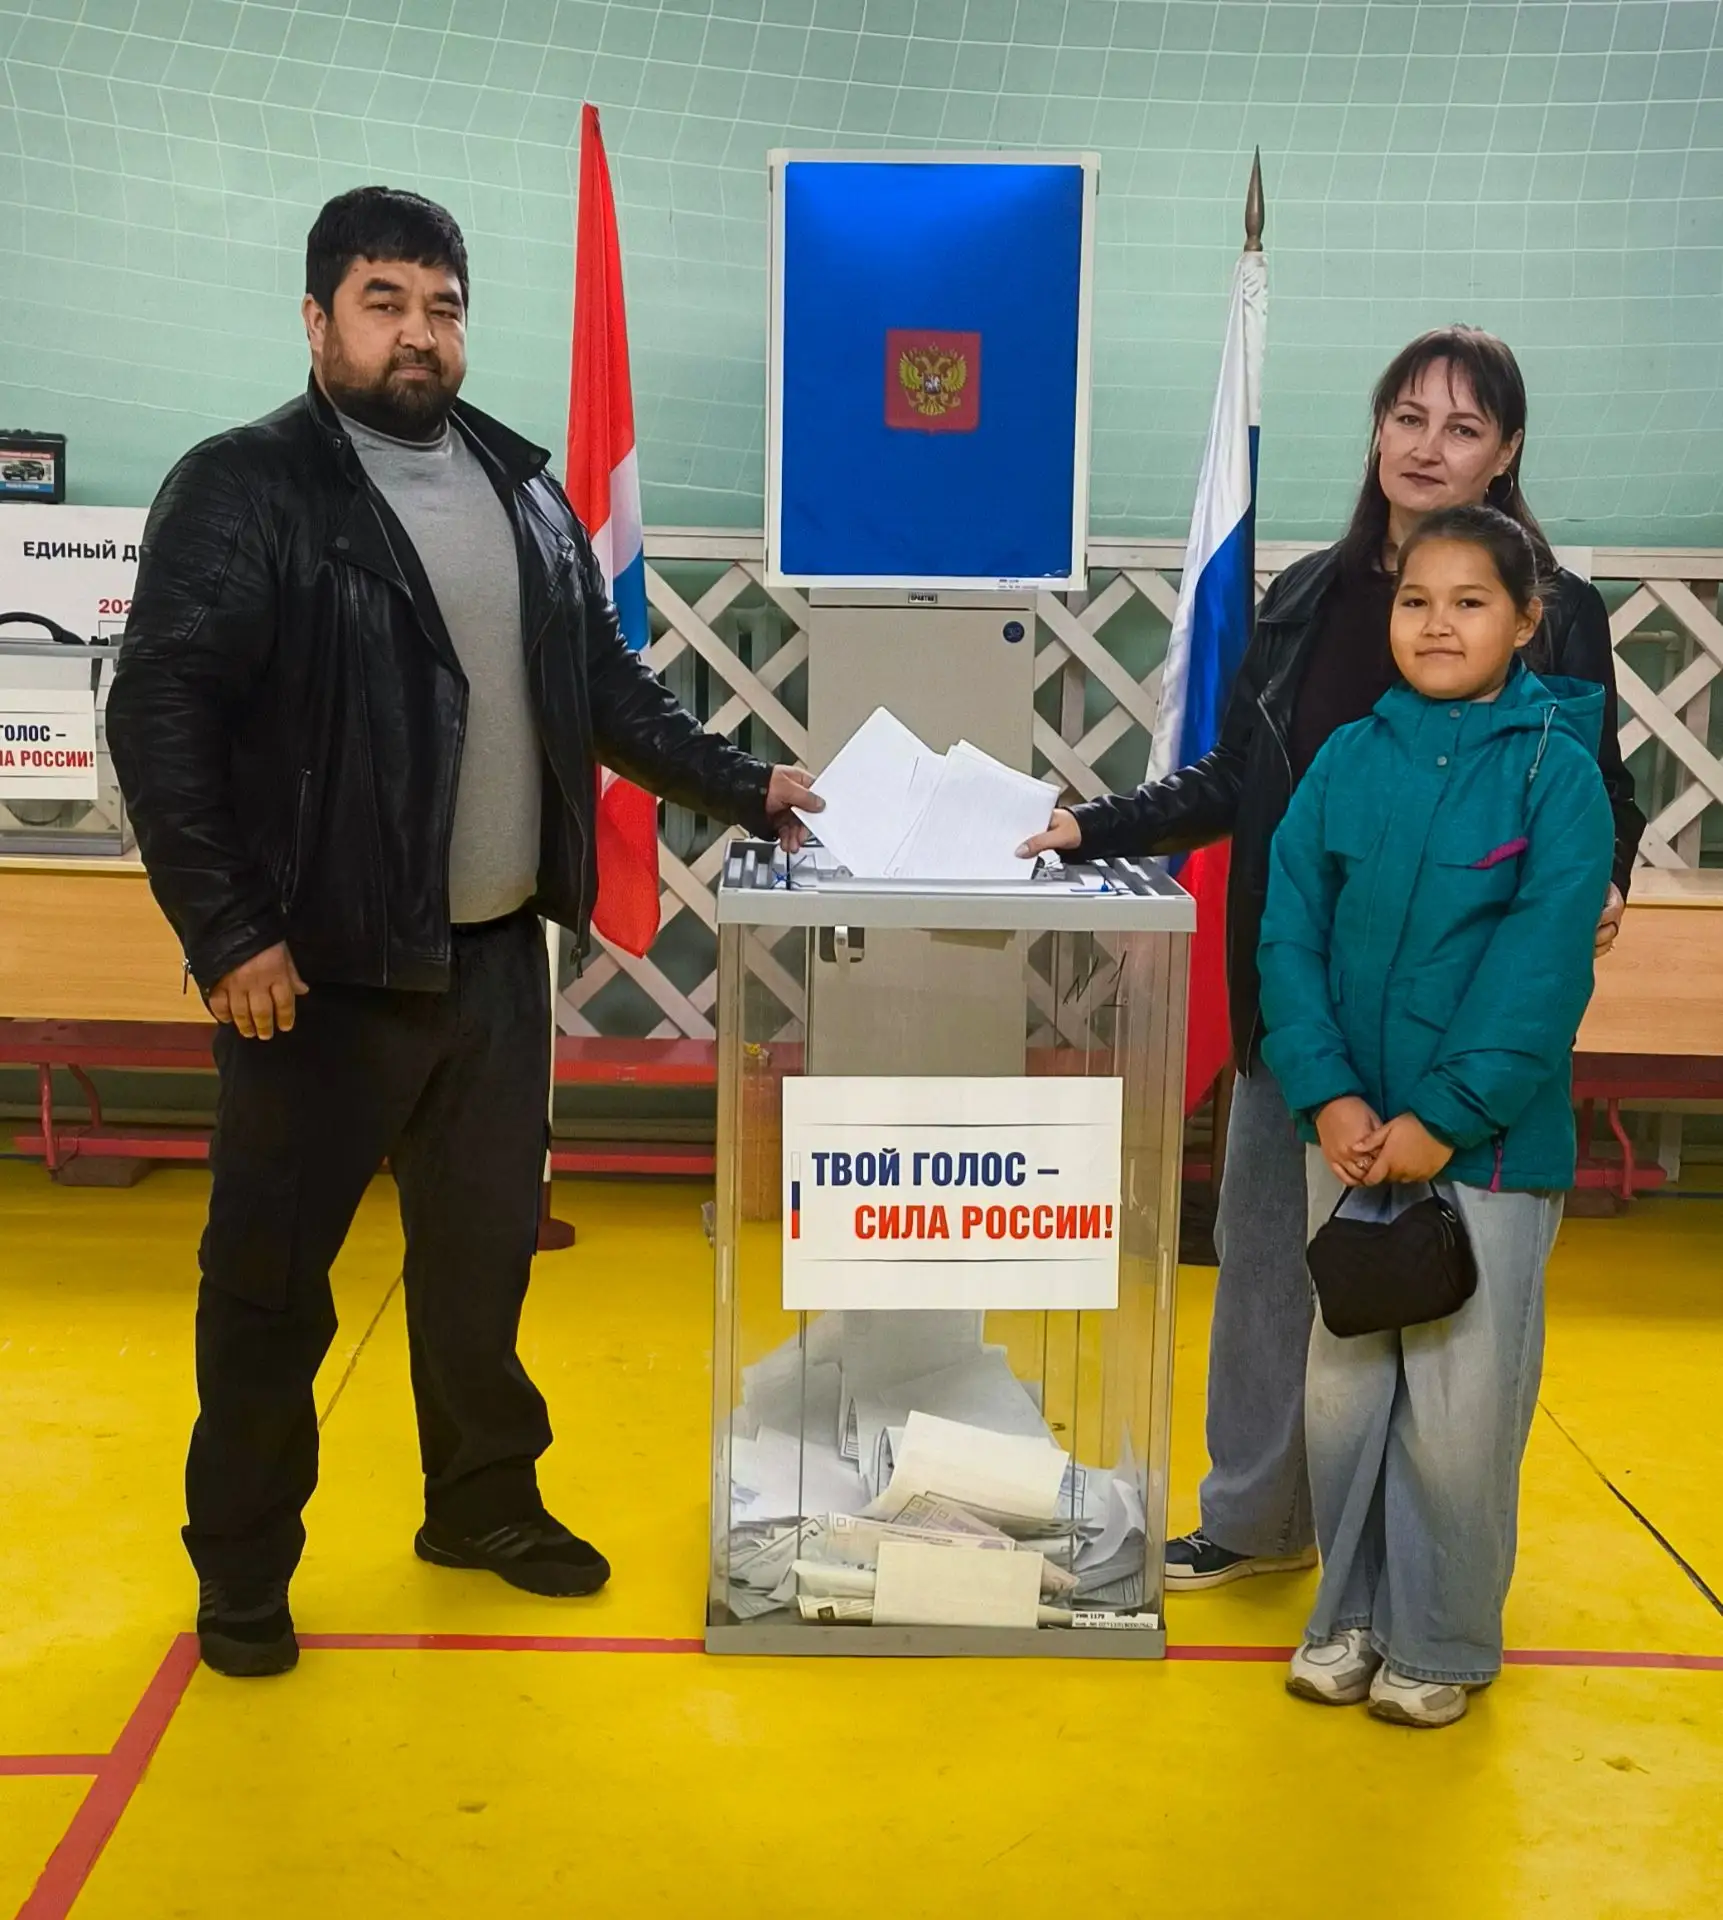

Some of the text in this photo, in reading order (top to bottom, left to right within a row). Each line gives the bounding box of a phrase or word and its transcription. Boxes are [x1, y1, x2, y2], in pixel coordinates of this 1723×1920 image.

[23, 539, 141, 562] ЕДИНЫЙ Д
[20, 750, 94, 767] РОССИИ!
[811, 1147, 900, 1186] ТВОЙ
[913, 1151, 1026, 1187] ГОЛОС
[854, 1204, 1113, 1239] СИЛА РОССИИ!
